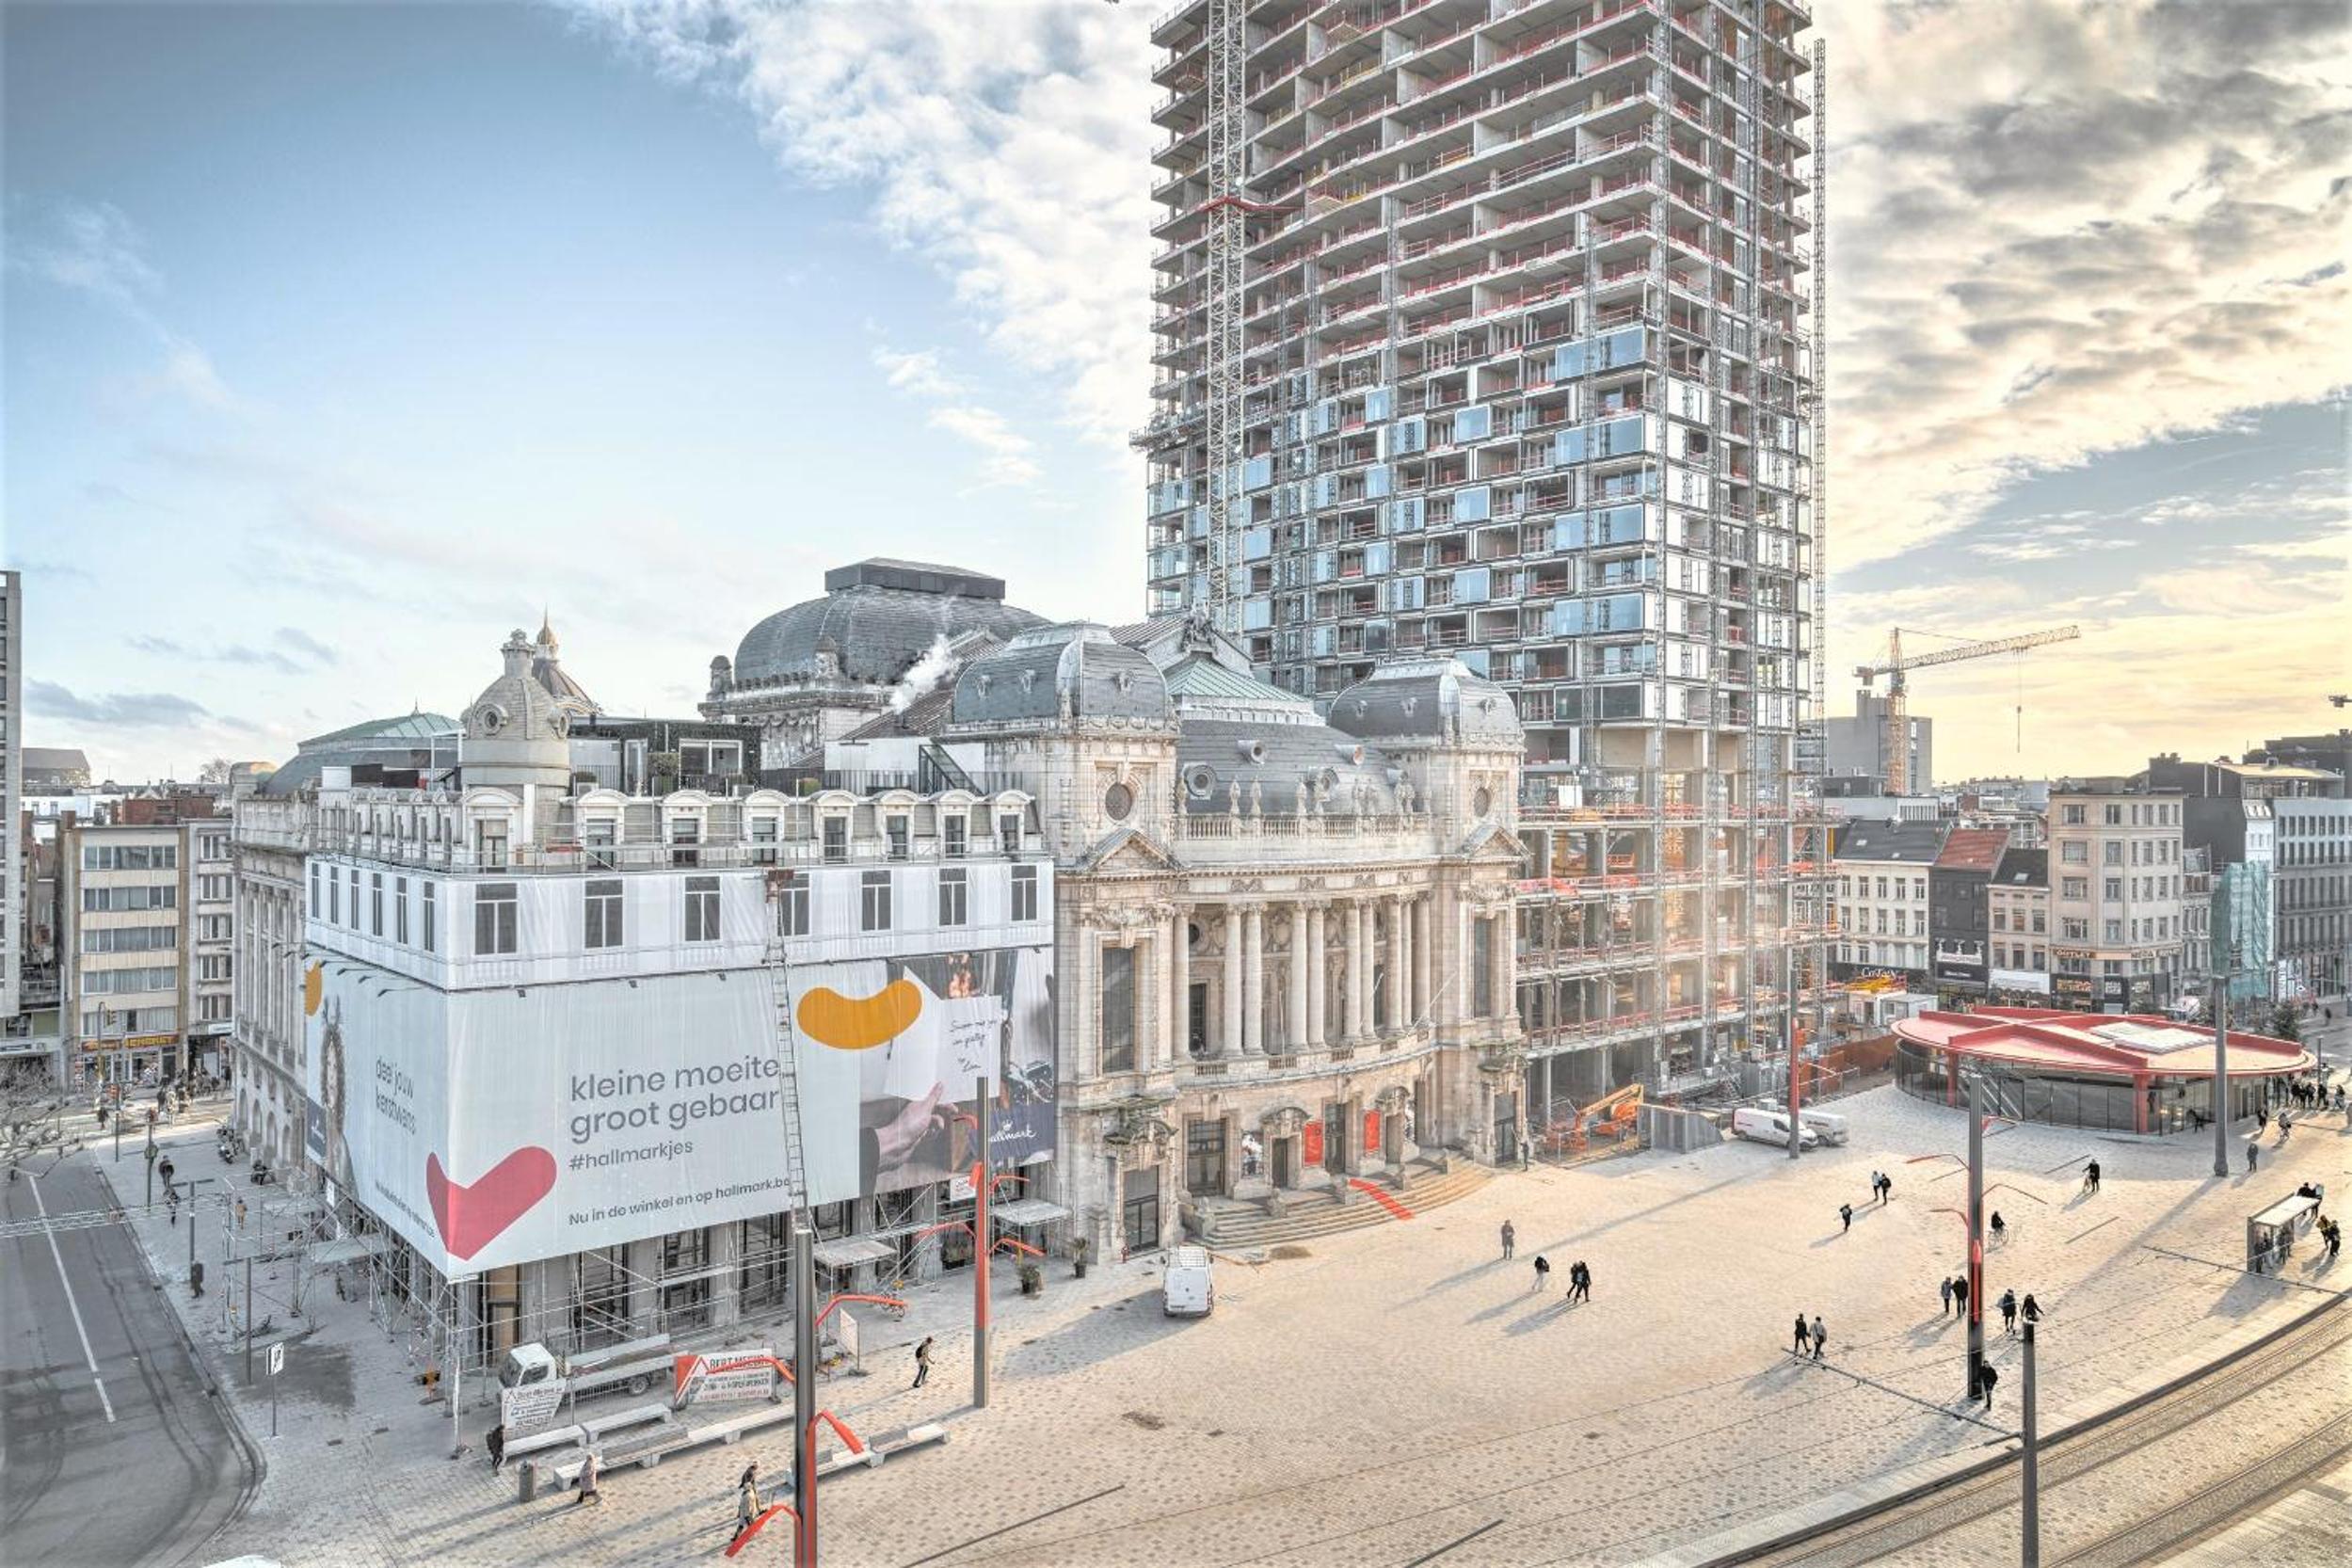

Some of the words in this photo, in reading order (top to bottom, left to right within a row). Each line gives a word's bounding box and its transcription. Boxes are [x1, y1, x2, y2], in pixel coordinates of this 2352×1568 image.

[571, 1069, 665, 1101] kleine
[675, 1055, 779, 1089] moeite
[570, 1102, 660, 1144] groot
[668, 1090, 779, 1130] gebaar
[568, 1141, 694, 1171] #hallmarkjes
[568, 1213, 588, 1226] Nu
[592, 1208, 605, 1222] in
[608, 1204, 627, 1218] de
[629, 1195, 673, 1215] winkel
[676, 1194, 693, 1207] en
[696, 1191, 712, 1207] op
